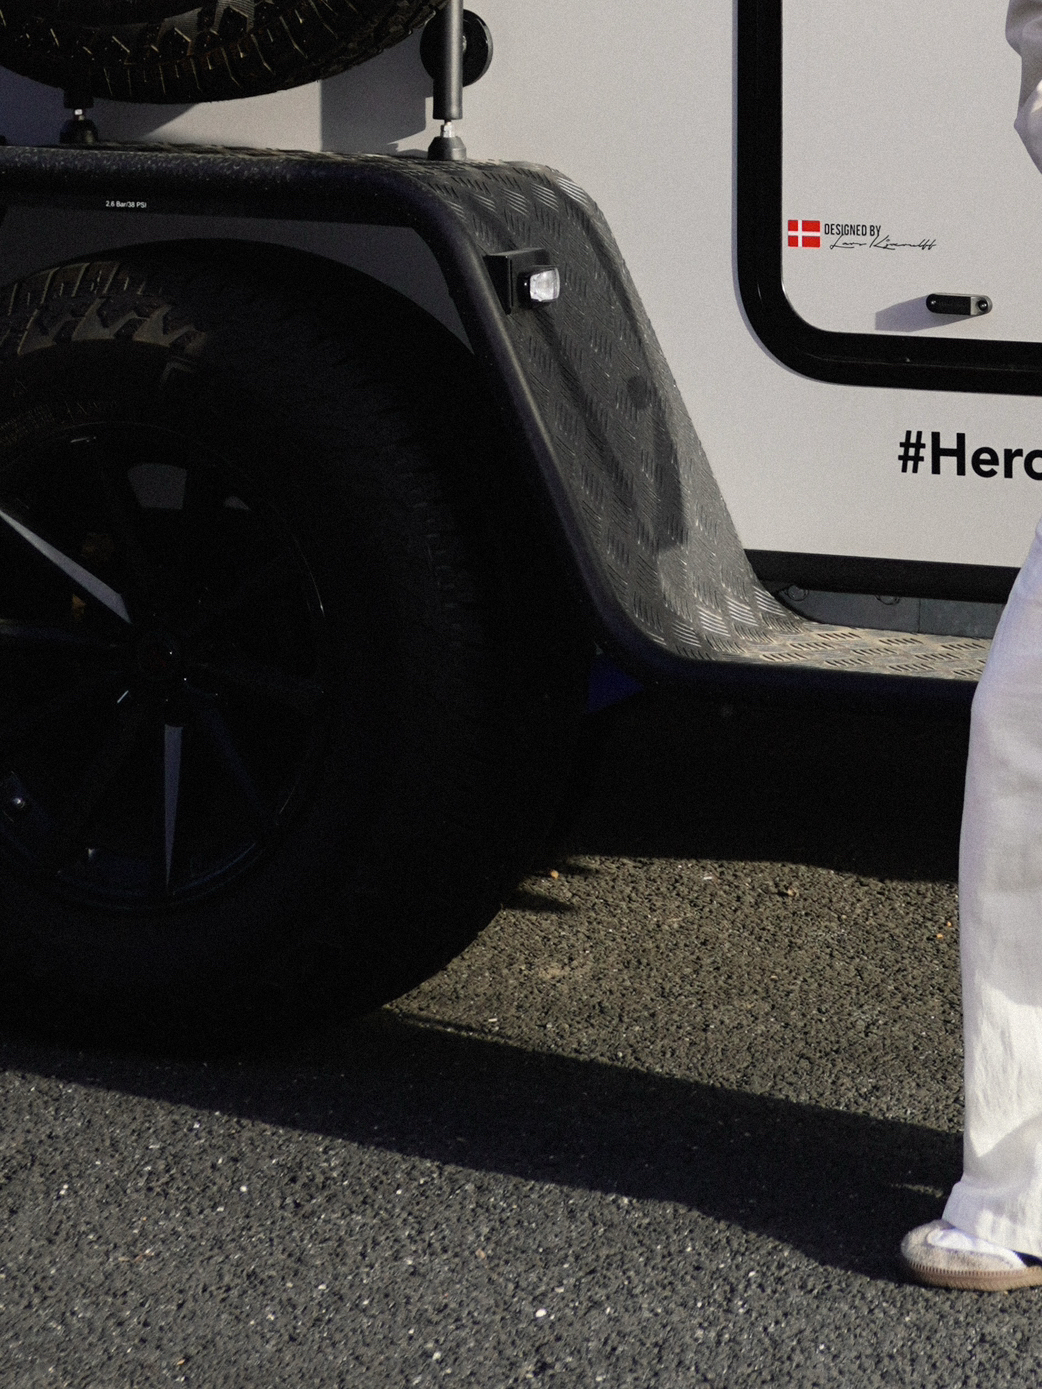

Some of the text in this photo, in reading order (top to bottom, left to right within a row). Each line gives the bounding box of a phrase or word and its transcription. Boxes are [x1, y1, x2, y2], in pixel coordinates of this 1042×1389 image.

[136, 201, 147, 209] PSI
[824, 223, 882, 237] DESIGNED BY
